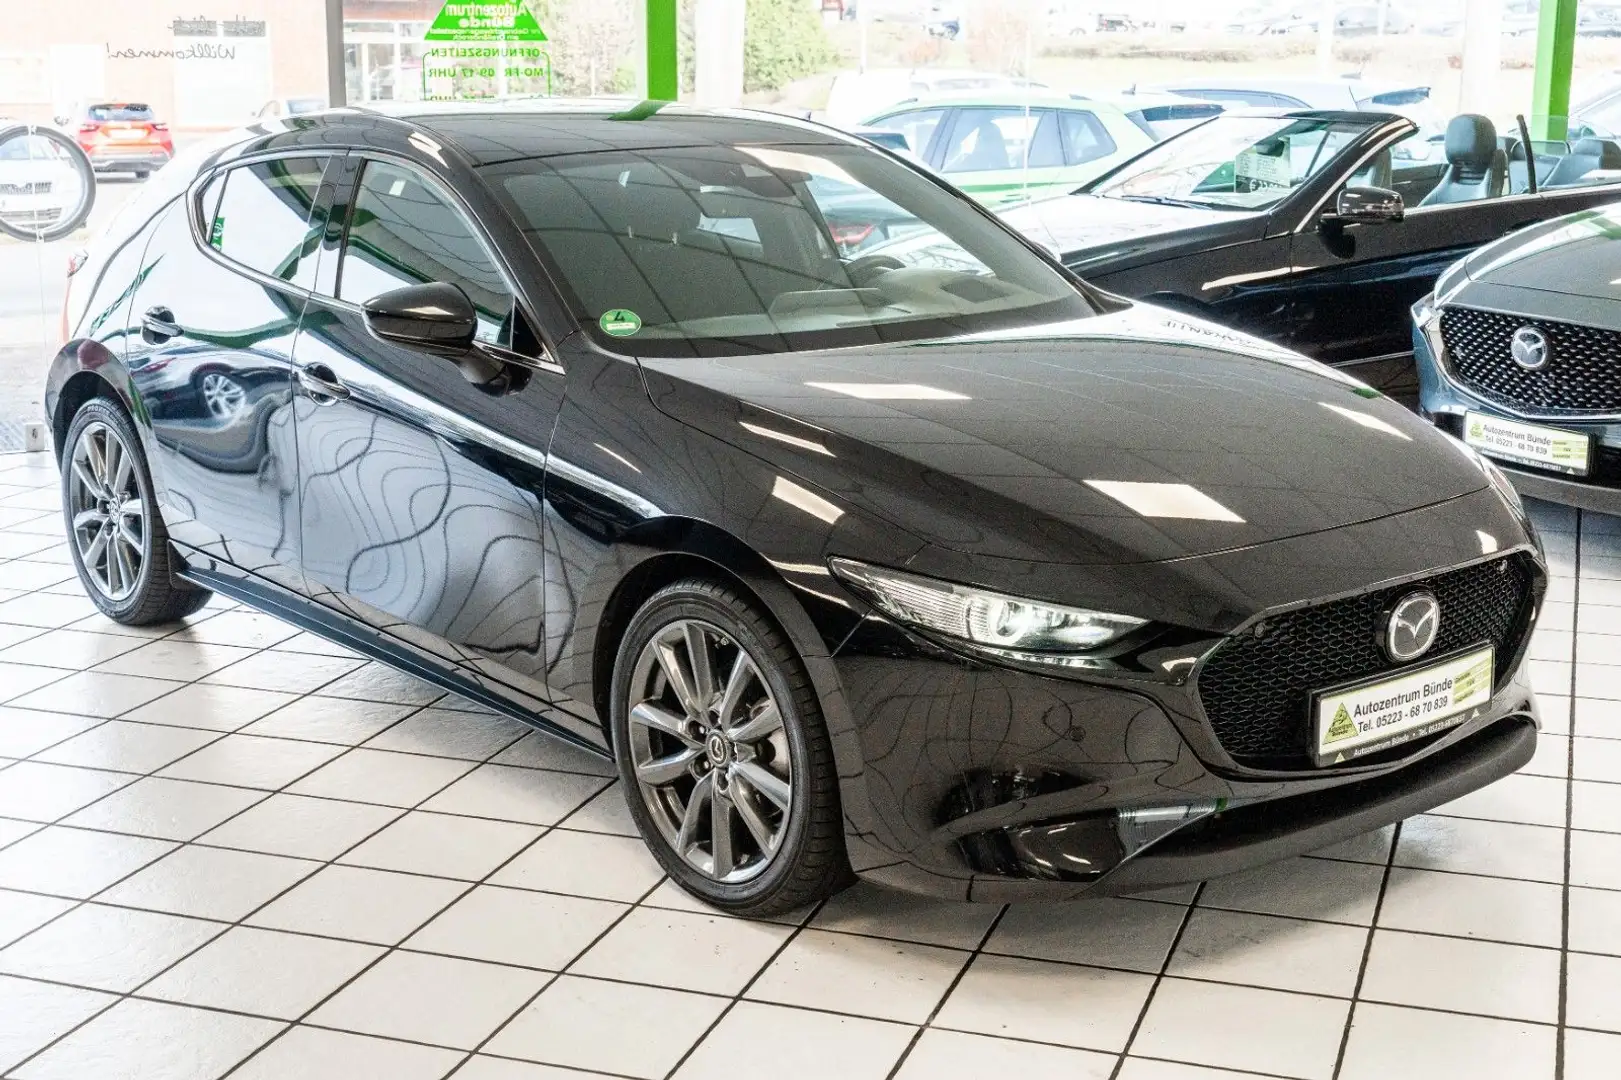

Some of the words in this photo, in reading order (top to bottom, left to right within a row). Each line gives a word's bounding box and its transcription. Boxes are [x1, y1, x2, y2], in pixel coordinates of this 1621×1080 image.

[1483, 424, 1526, 440] Autozentrum
[1354, 690, 1420, 717] Autozentrum
[1423, 678, 1453, 697] Bünde
[1358, 719, 1374, 733] Tel.
[1376, 710, 1403, 728] 05223
[1410, 705, 1420, 718] 68
[1423, 701, 1433, 713] 70
[1434, 696, 1448, 710] 839
